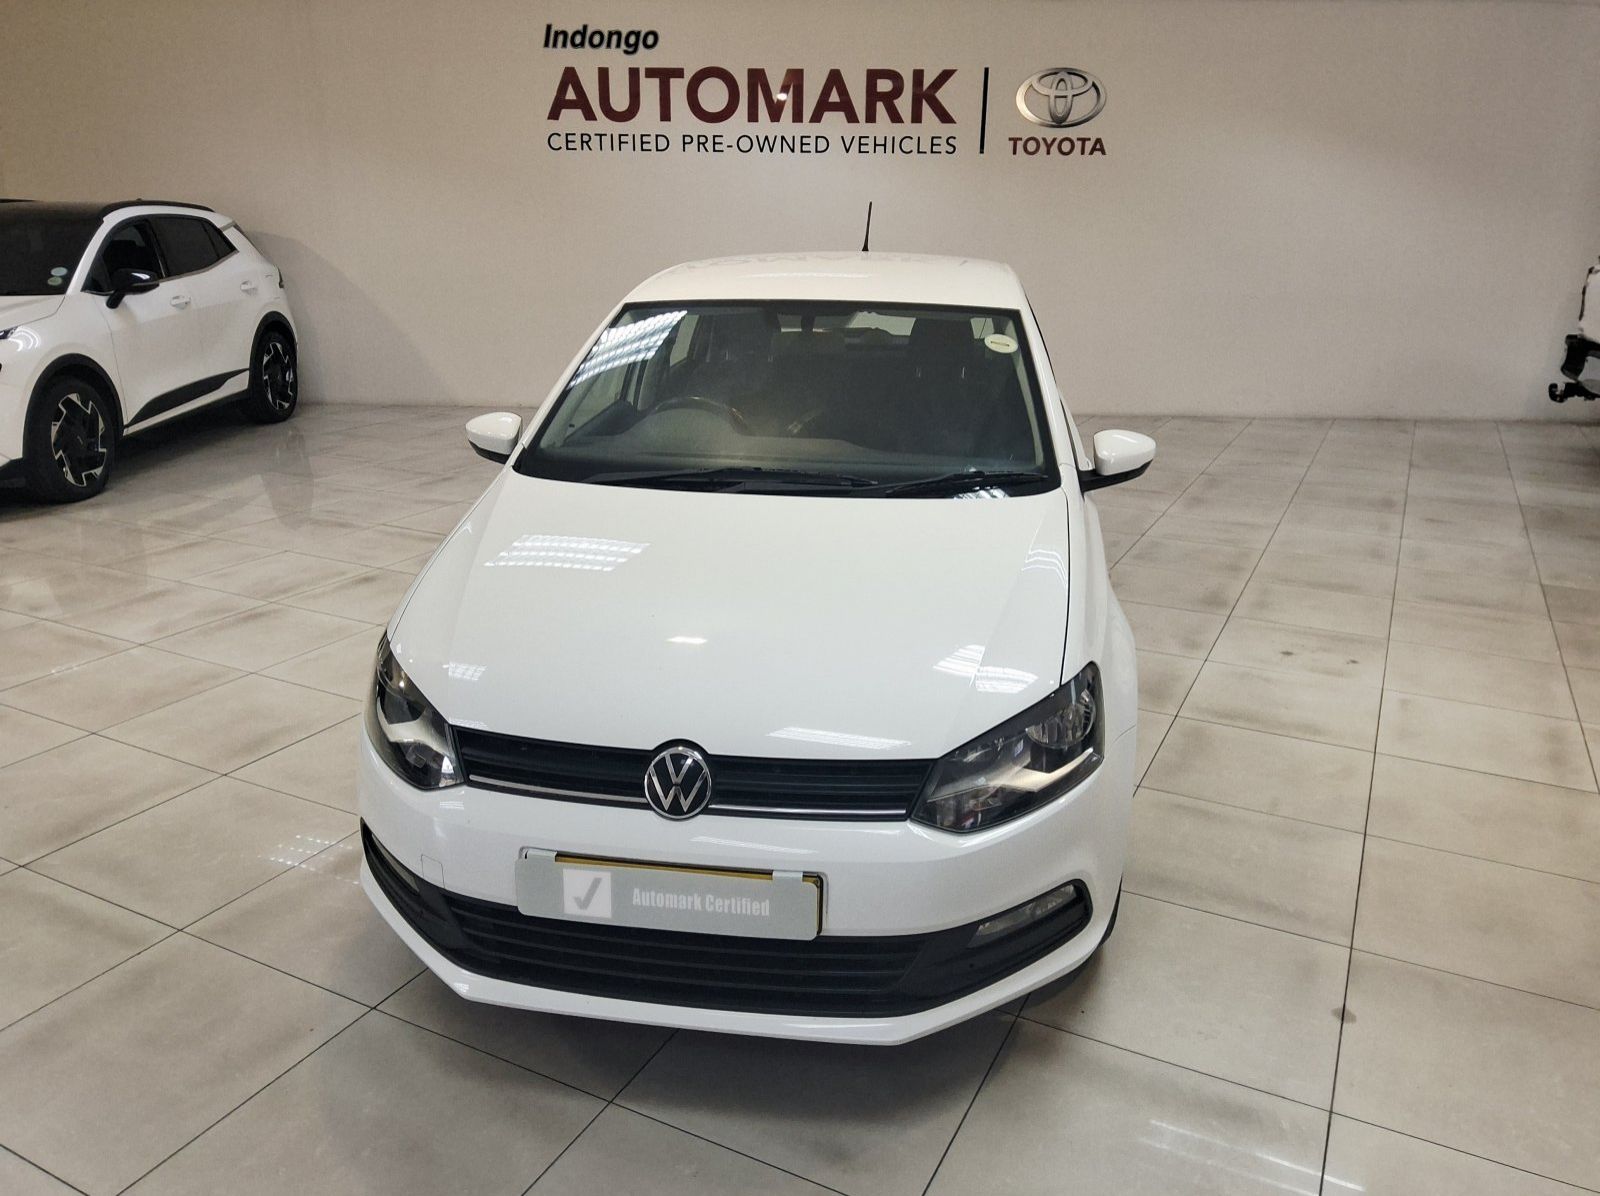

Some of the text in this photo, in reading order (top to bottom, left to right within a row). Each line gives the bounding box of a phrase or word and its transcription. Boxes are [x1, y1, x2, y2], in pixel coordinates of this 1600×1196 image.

[543, 24, 660, 55] Indongo
[547, 66, 958, 125] AUTOMARK
[547, 132, 958, 155] CERTIFIED PRE-OWNED VEHICLES
[1008, 137, 1107, 156] TOYOTA
[632, 887, 770, 917] Automark Certified
